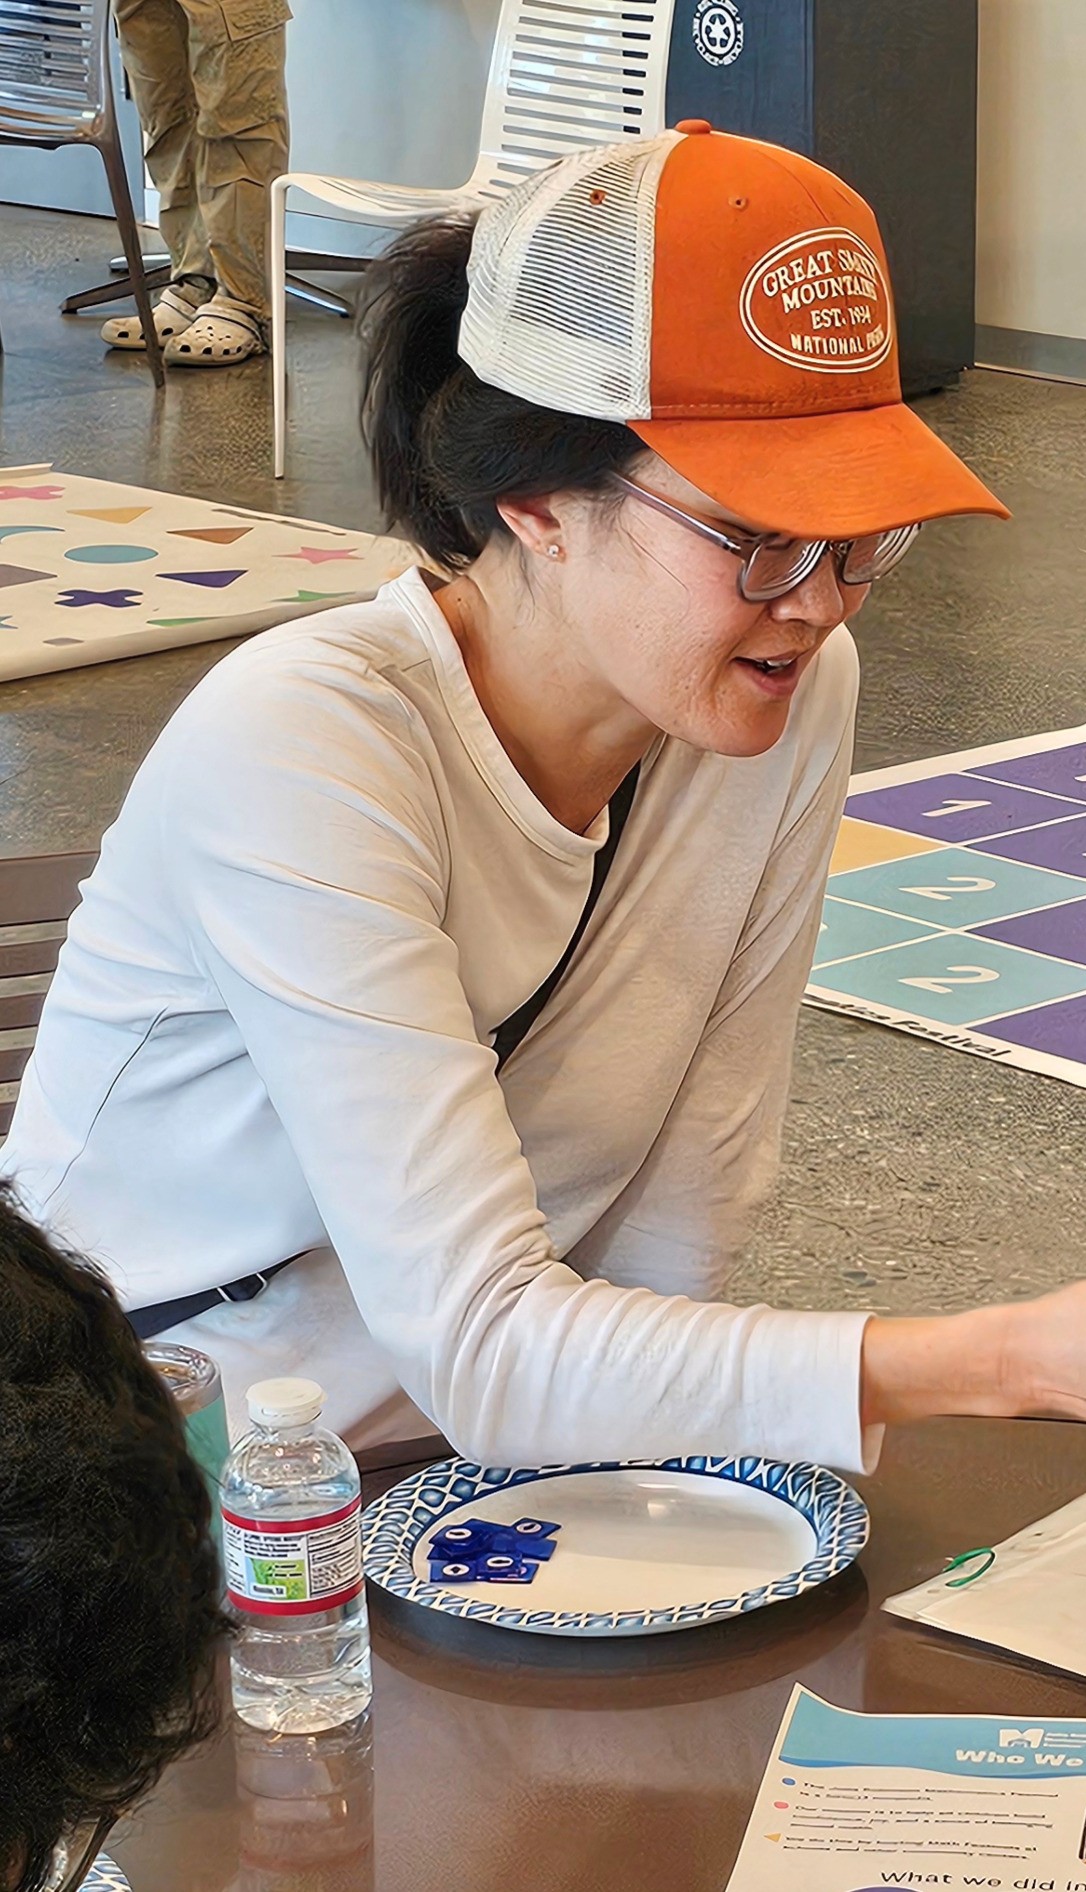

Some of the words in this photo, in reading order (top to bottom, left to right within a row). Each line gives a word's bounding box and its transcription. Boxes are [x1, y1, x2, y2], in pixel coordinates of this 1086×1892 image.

[763, 250, 833, 297] GREAT
[810, 308, 847, 330] EST.
[790, 332, 864, 355] NATIONAL
[922, 799, 992, 817] 1
[898, 876, 996, 900] 2
[897, 965, 999, 994] 2
[893, 1020, 1012, 1057] Festival
[956, 1750, 1025, 1765] Who
[1034, 1753, 1084, 1767] We
[881, 1872, 953, 1884] What
[963, 1877, 1002, 1888] we
[1013, 1878, 1055, 1891] did
